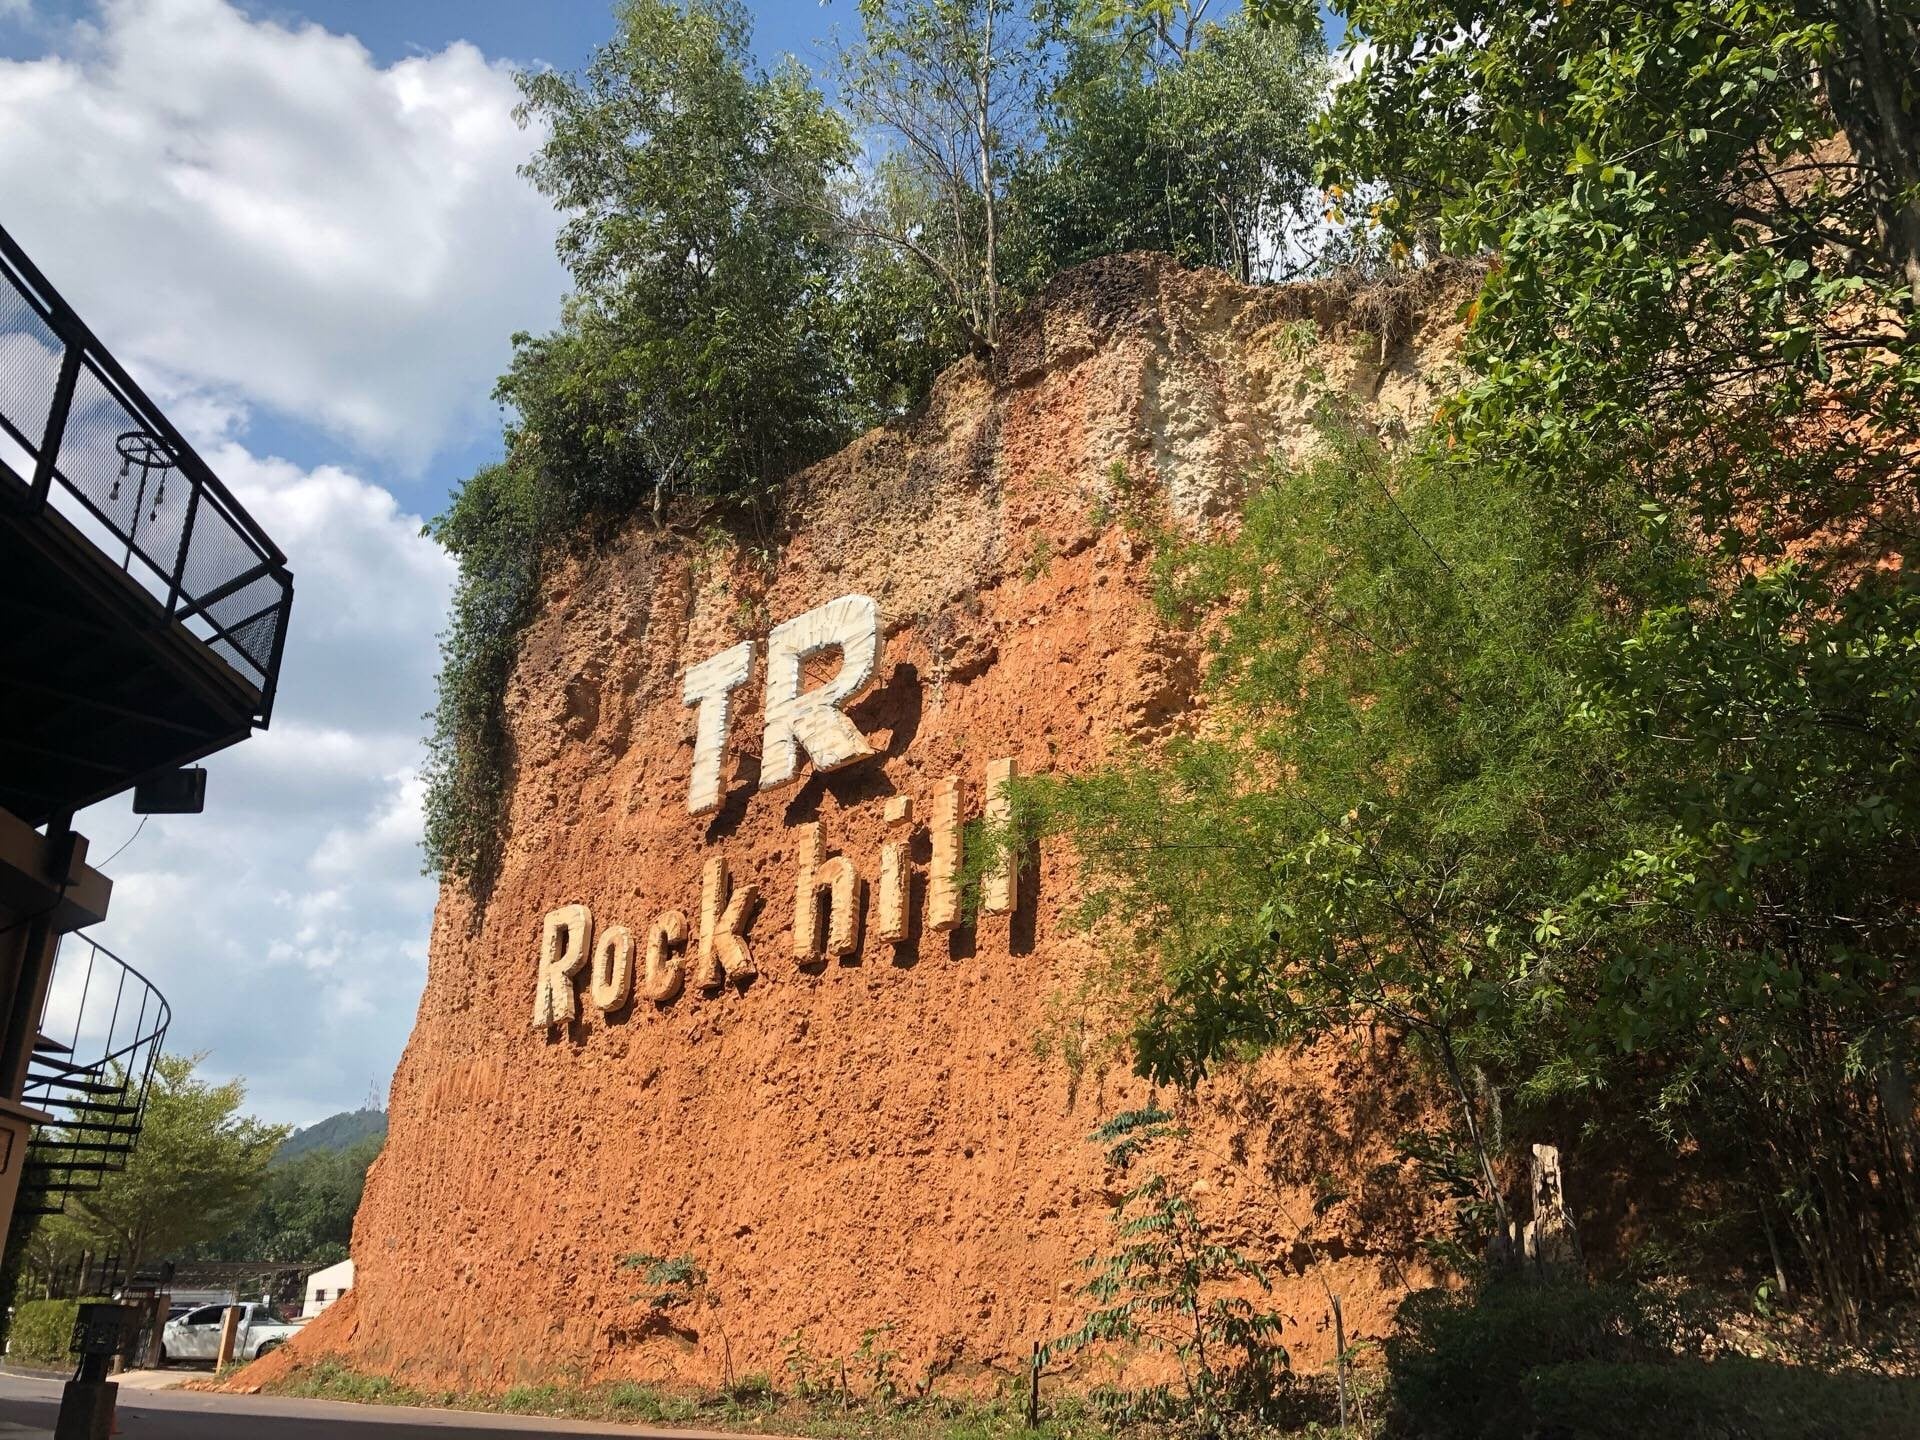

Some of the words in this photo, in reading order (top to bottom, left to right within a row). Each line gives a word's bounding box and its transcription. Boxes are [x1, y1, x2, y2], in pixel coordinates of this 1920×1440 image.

[684, 594, 883, 815] TR
[533, 857, 757, 1029] Rock
[794, 757, 1018, 965] hill
